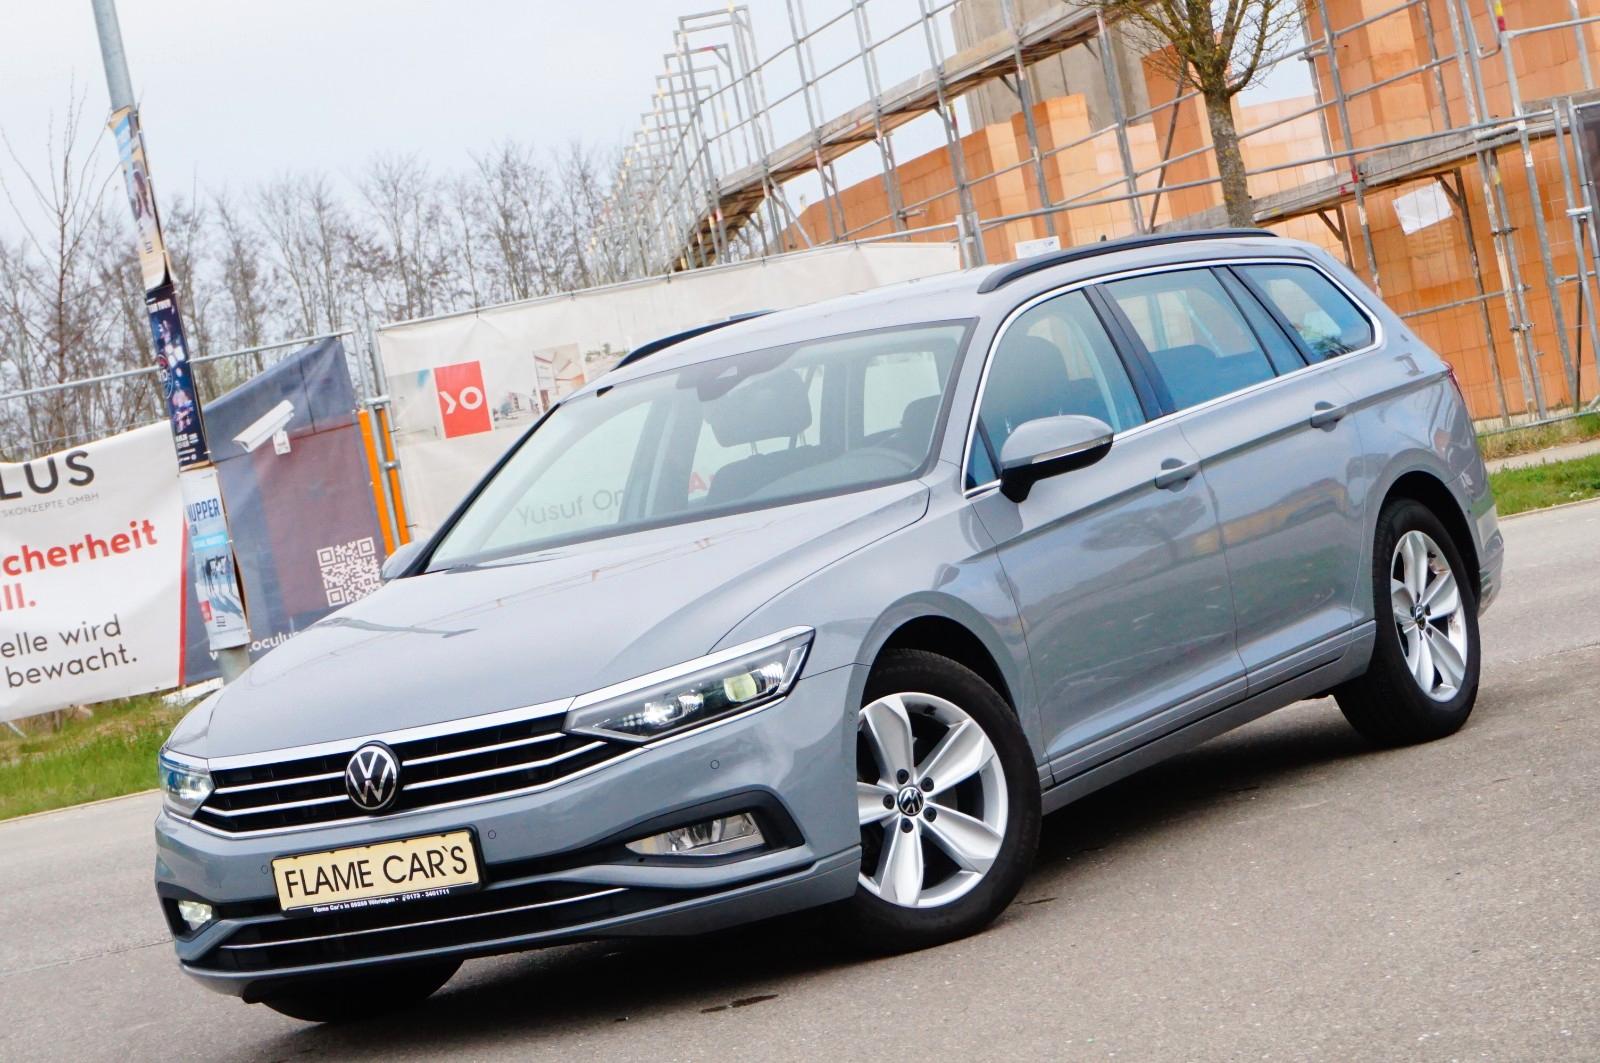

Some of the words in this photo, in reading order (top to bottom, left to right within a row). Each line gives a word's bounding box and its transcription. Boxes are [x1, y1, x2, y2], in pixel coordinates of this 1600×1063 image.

[67, 492, 100, 507] GMBH
[516, 496, 583, 526] Yusuf
[2, 519, 158, 576] cherheit
[0, 582, 37, 612] ll.
[0, 631, 48, 658] elle
[58, 613, 121, 646] wird
[5, 643, 138, 688] bewacht.
[284, 859, 375, 899] FLAME
[382, 845, 468, 884] CAR'S
